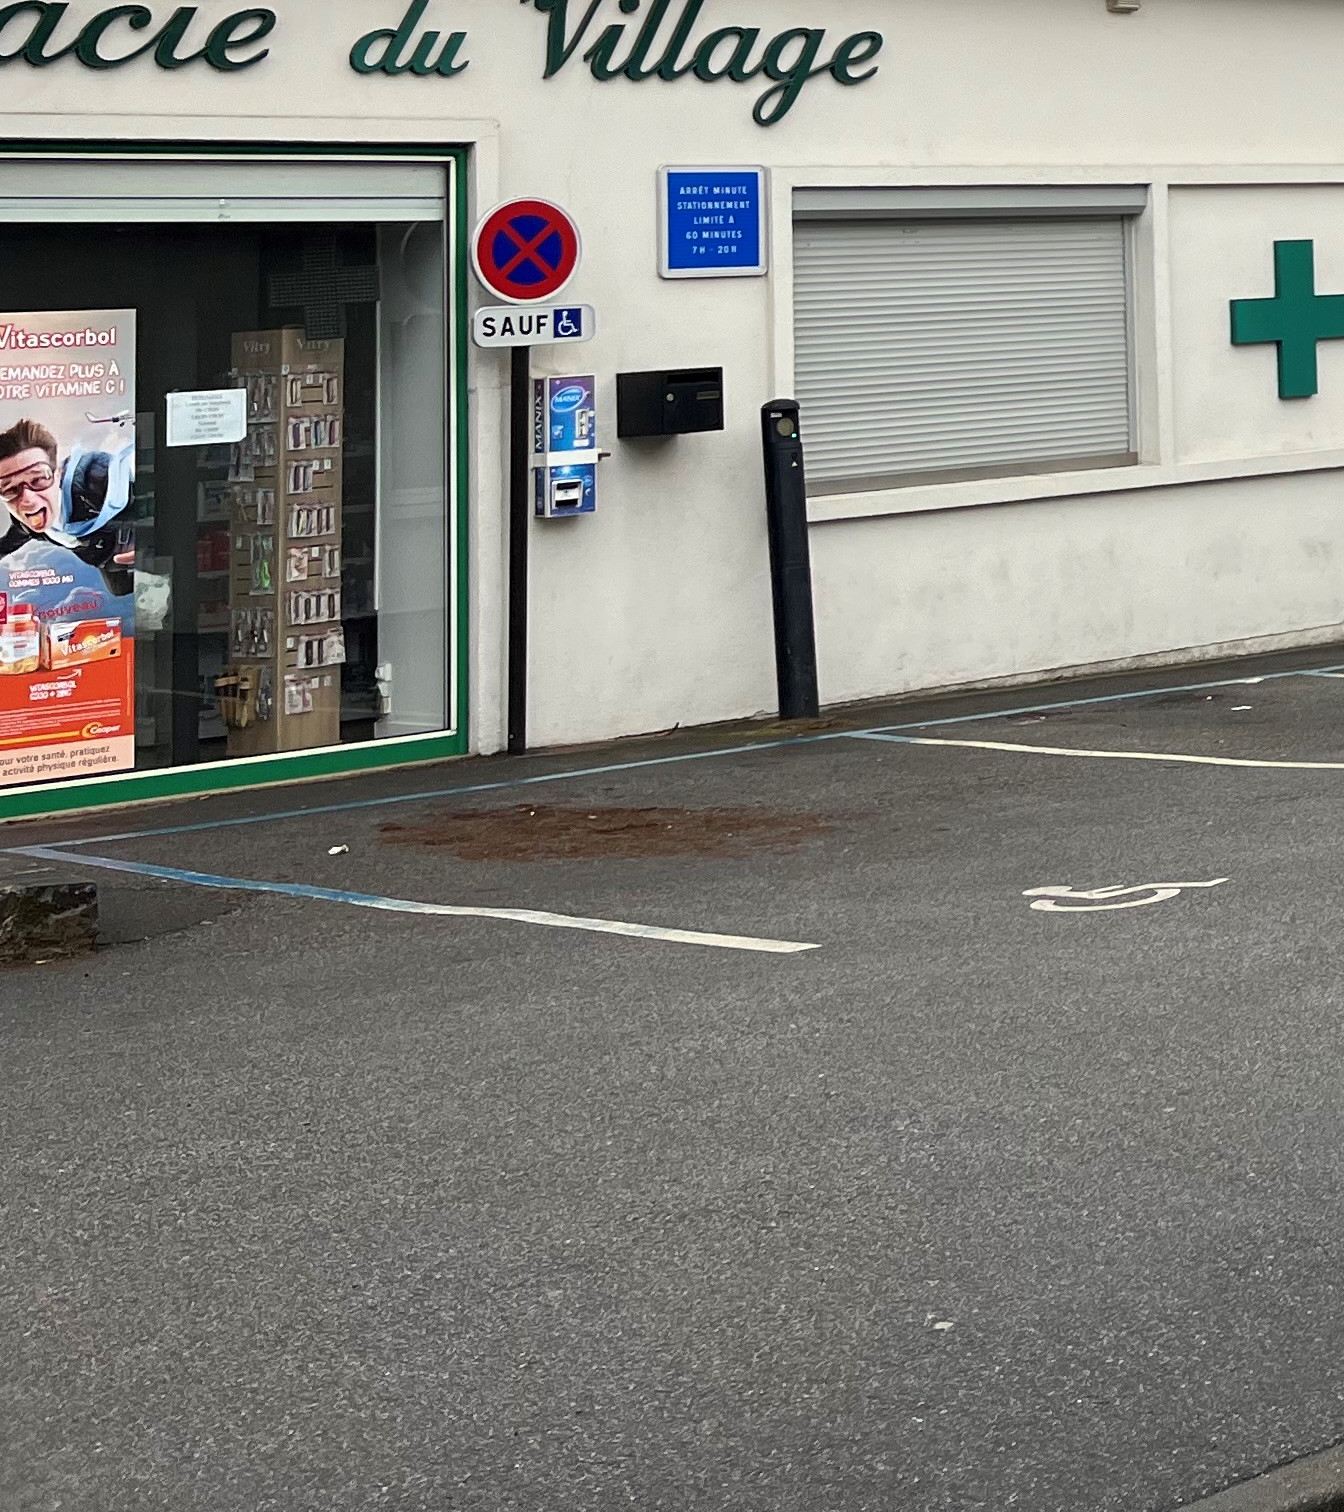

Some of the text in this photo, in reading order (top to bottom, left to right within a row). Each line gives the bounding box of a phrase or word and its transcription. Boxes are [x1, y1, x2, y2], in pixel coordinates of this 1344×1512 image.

[712, 186, 747, 195] MINUTE
[677, 200, 750, 210] STATIONNEMENT
[685, 230, 743, 240] 60 MINUTES
[482, 315, 548, 337] SAUF
[0, 324, 117, 348] Vitascorbol
[70, 364, 105, 379] PLUS
[109, 360, 119, 376] À
[106, 380, 115, 393] C
[535, 395, 543, 450] MANIX
[16, 754, 39, 764] votre
[41, 749, 67, 760] santé,
[70, 745, 110, 758] pratiquez
[2, 754, 119, 777] activité physique régulière.
